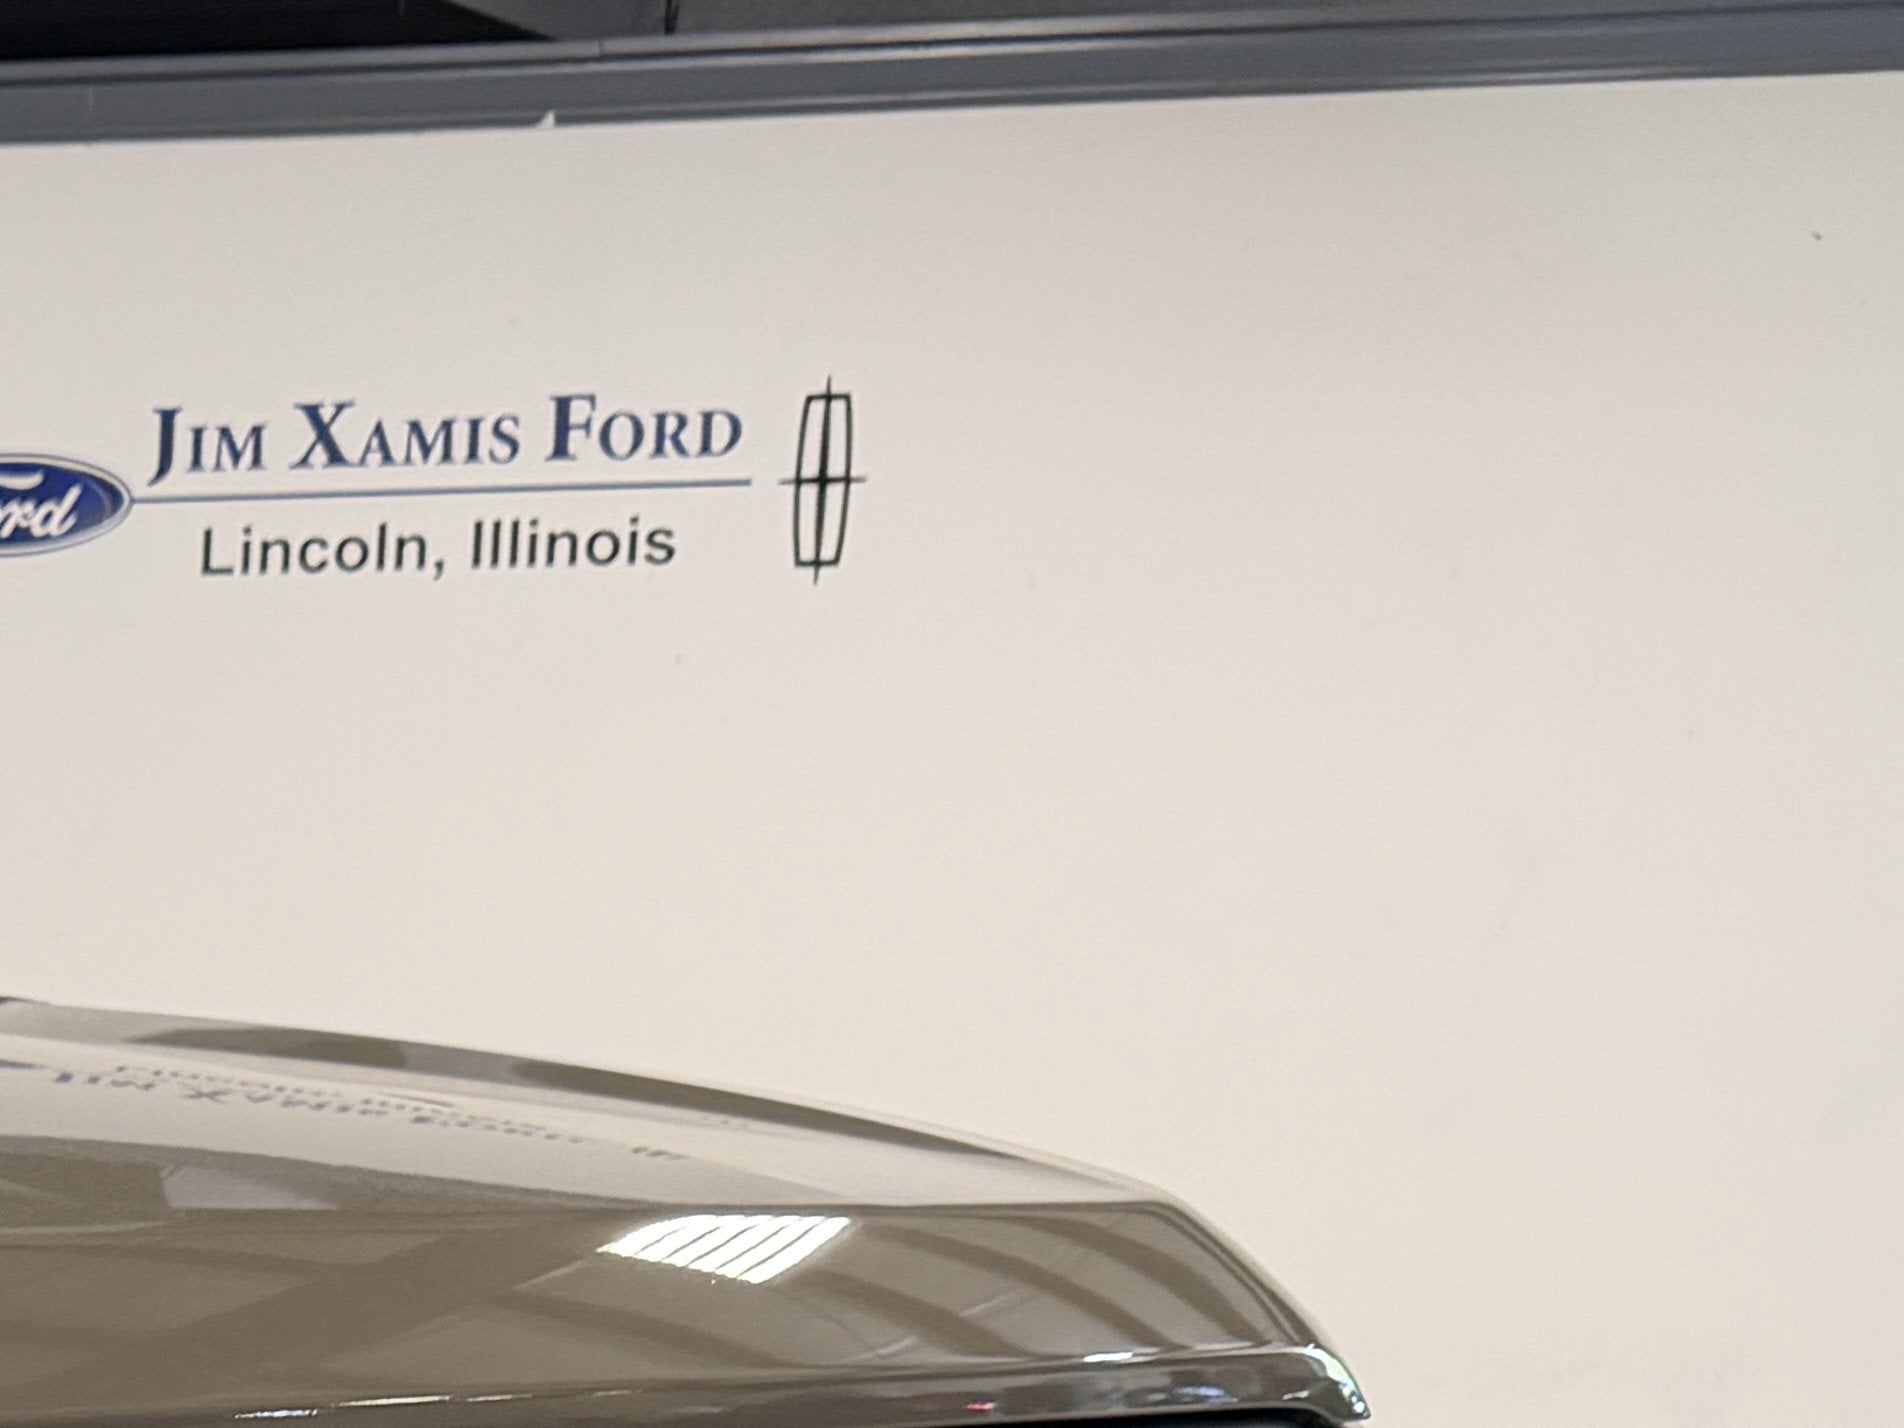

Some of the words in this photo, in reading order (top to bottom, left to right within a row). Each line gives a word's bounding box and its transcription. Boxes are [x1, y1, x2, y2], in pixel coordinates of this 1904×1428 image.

[148, 406, 267, 486] JIM
[289, 399, 521, 471] XAMIS
[545, 394, 742, 463] FORD
[201, 522, 445, 580] Lincoln,
[470, 514, 676, 570] Illinois
